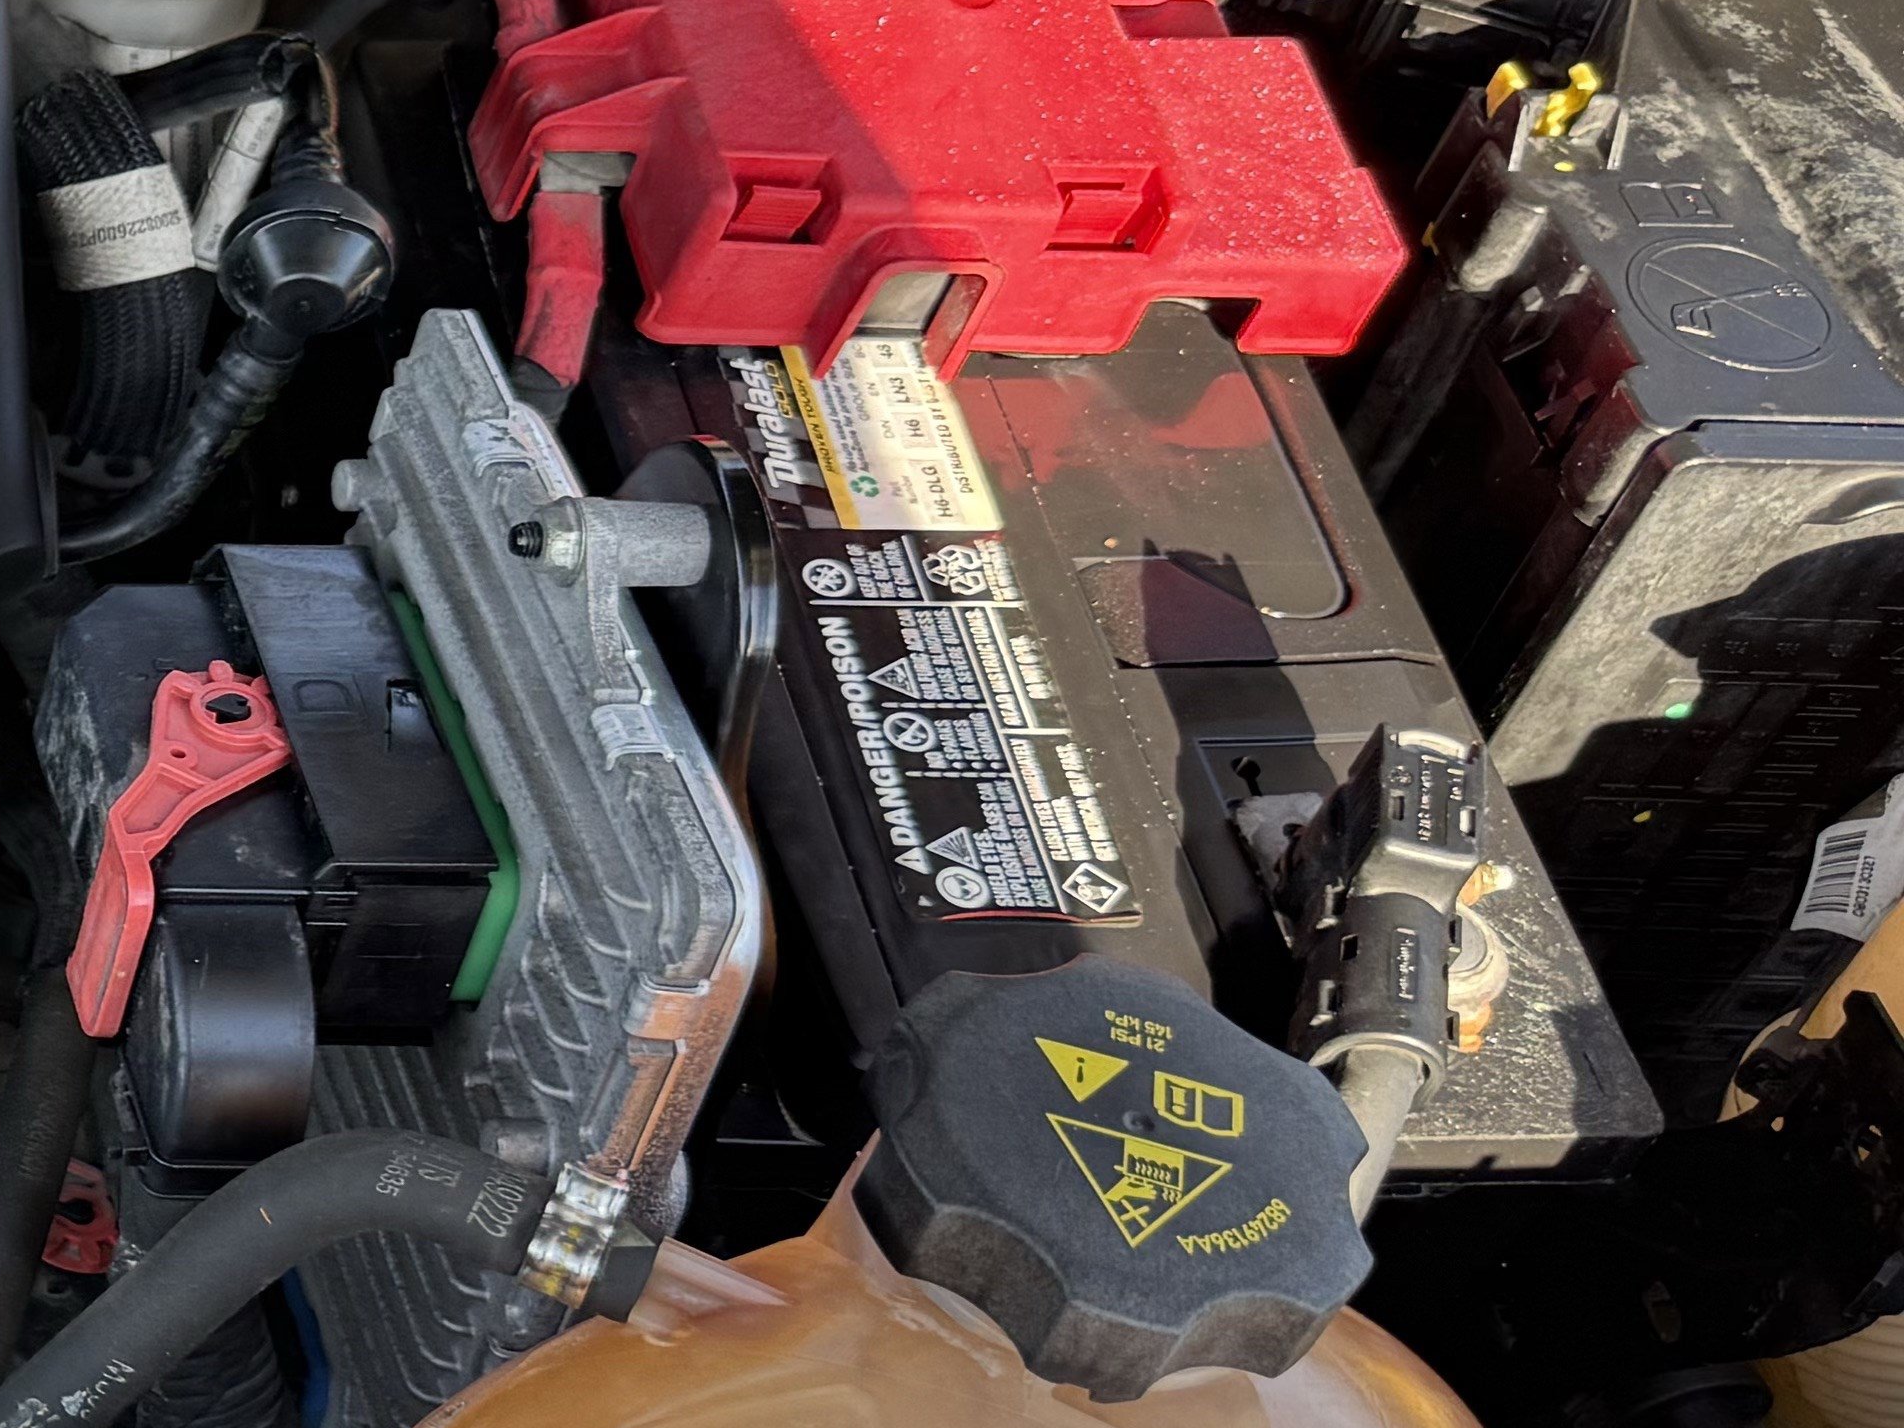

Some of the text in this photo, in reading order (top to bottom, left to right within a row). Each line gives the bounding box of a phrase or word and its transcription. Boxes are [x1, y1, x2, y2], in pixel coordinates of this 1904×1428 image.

[764, 360, 793, 418] GOLD
[840, 358, 870, 421] GROUP SIZE
[866, 382, 879, 396] EN
[889, 377, 910, 403] LN3
[730, 357, 801, 488] Duralast
[795, 377, 835, 473] PROVEN TOUGH
[881, 420, 895, 438] DIN
[904, 419, 924, 437] H6
[931, 409, 946, 420] BY
[938, 424, 973, 493] DISTRIBUTED
[921, 466, 952, 517] H6-DLG
[845, 544, 879, 598] KEEP OUT OF
[877, 582, 896, 598] THE
[897, 587, 916, 598] OF
[896, 608, 943, 700] SULFURIC ACID CAN
[915, 611, 960, 700] CAUSE BLINDNESS
[946, 646, 974, 683] SEVERE
[960, 685, 980, 700] OR
[996, 694, 1023, 726] READ
[818, 617, 918, 846] DANGER/POISON
[934, 720, 962, 760] SPARKS
[952, 720, 982, 760] FLAMES
[969, 713, 1001, 760] SMOKING
[924, 752, 950, 768] NO
[1010, 739, 1071, 861] FLUSH EYES IMMEDIATELY
[1065, 771, 1095, 796] HELP
[1007, 814, 1026, 826] OR
[1076, 797, 1111, 840] MEDICAL
[976, 782, 1035, 906] EXPLOSIVE GASES CAN
[1012, 828, 1043, 876] BLINDNESS
[1065, 834, 1093, 860] WITH
[1091, 841, 1119, 861] GET
[984, 865, 1015, 906] SHIELD
[1029, 878, 1056, 907] CAUSE
[1104, 1009, 1174, 1040] 145 kPa
[1110, 1027, 1165, 1053] 21 PSI
[1176, 1197, 1293, 1257] 68249136AA
